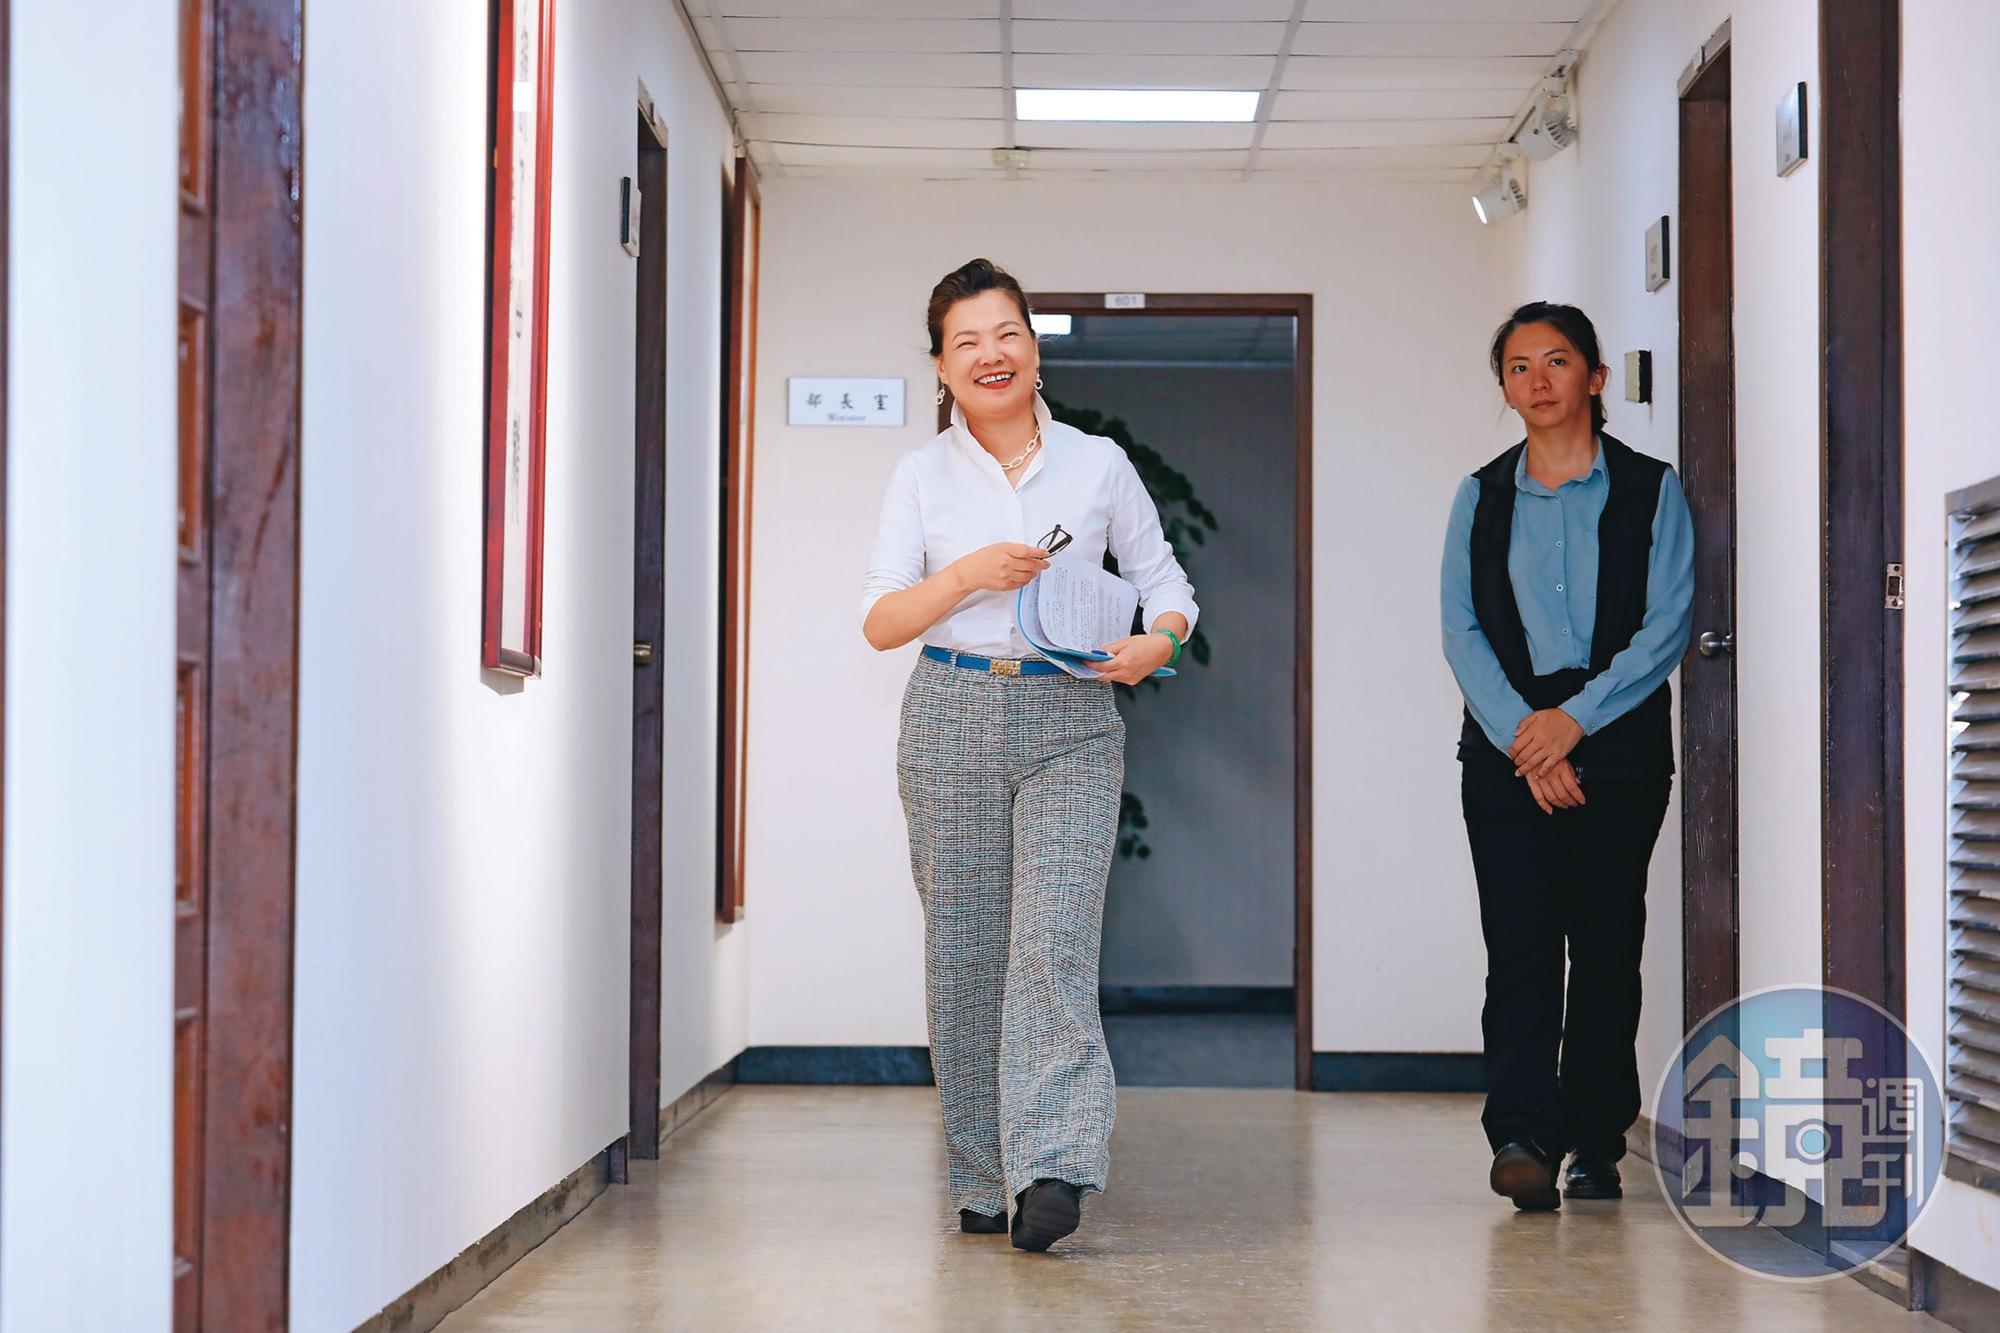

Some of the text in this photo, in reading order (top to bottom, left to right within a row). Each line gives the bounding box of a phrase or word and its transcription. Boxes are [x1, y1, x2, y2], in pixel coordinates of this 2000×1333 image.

[1114, 295, 1137, 306] 601
[806, 391, 889, 411] 部長室
[827, 412, 866, 422] Minister
